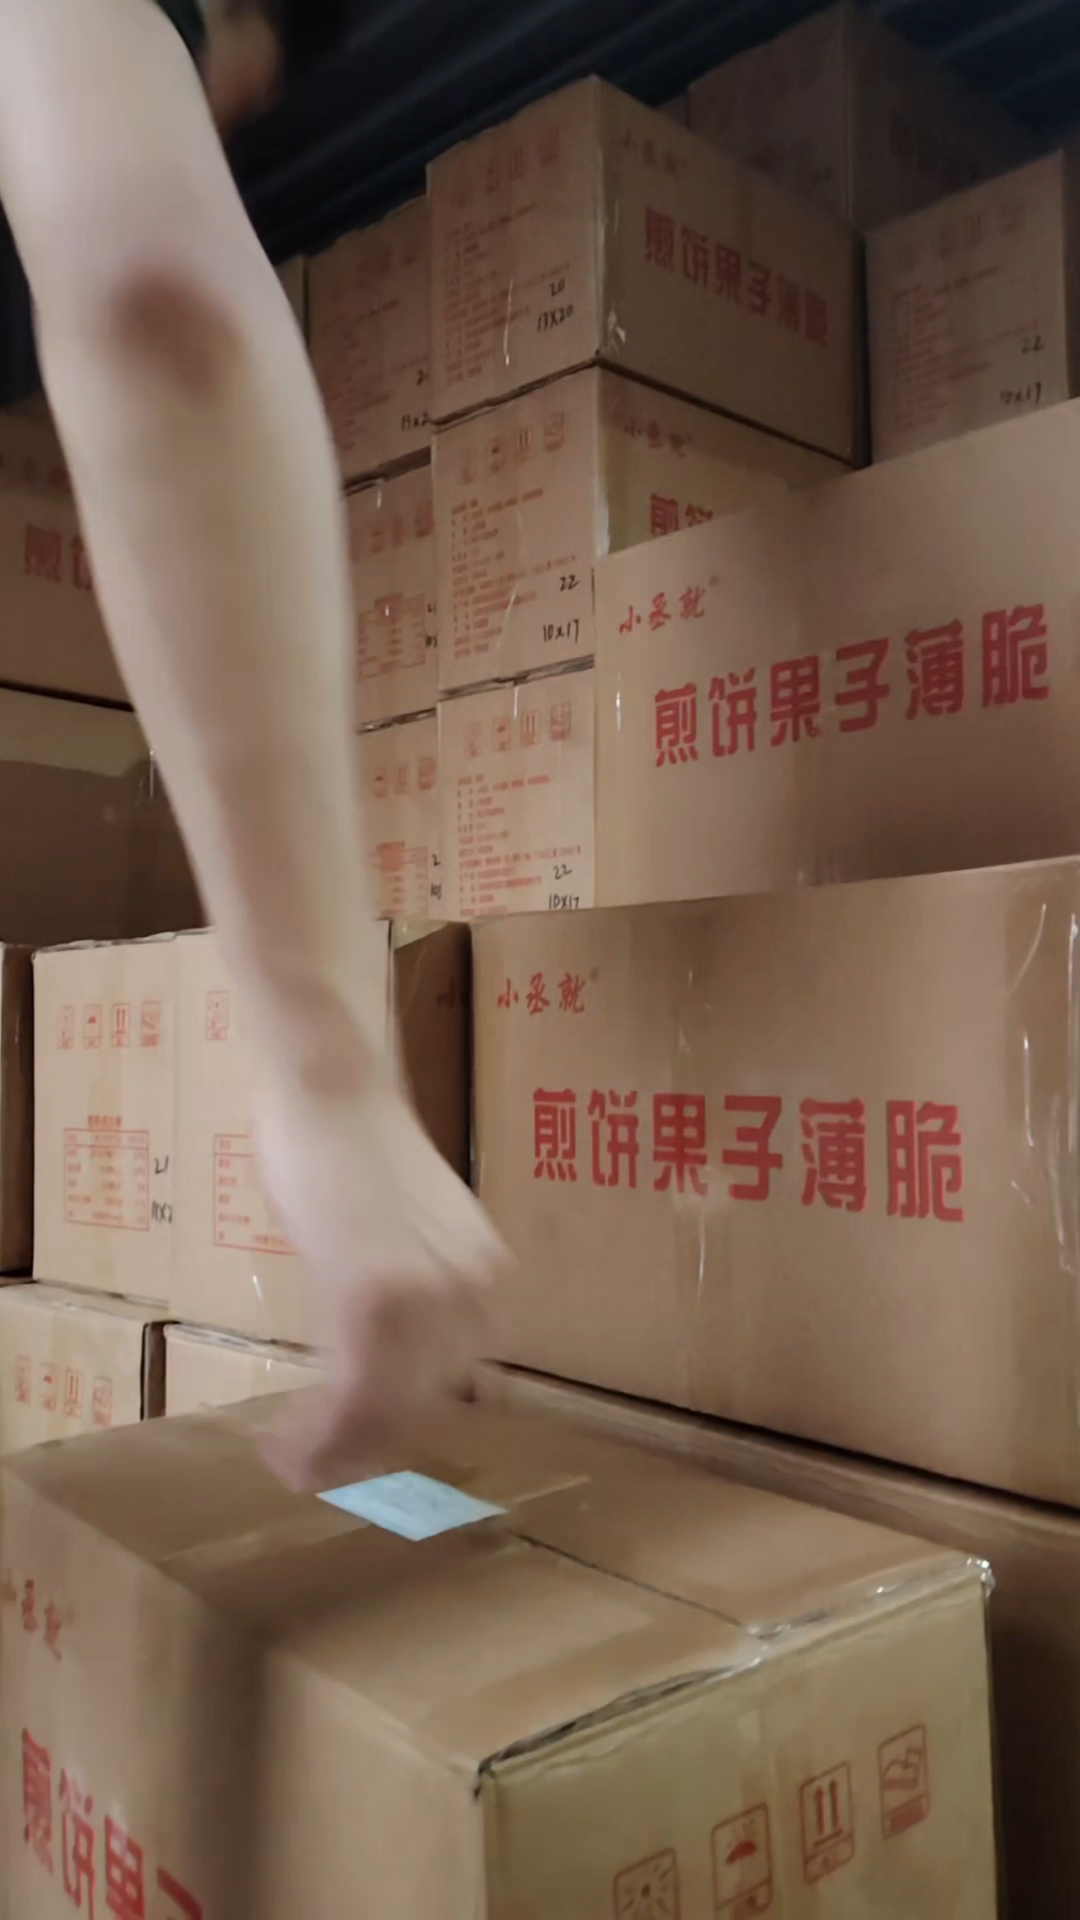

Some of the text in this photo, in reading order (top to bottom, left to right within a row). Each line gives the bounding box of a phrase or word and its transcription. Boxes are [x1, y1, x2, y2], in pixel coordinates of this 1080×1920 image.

[559, 574, 580, 592] 22
[654, 603, 1050, 767] 煎饼果子薄脆
[553, 863, 573, 881] 22
[533, 1086, 965, 1225] 煎饼果子薄脆
[22, 1726, 205, 1920] 煎饼果
